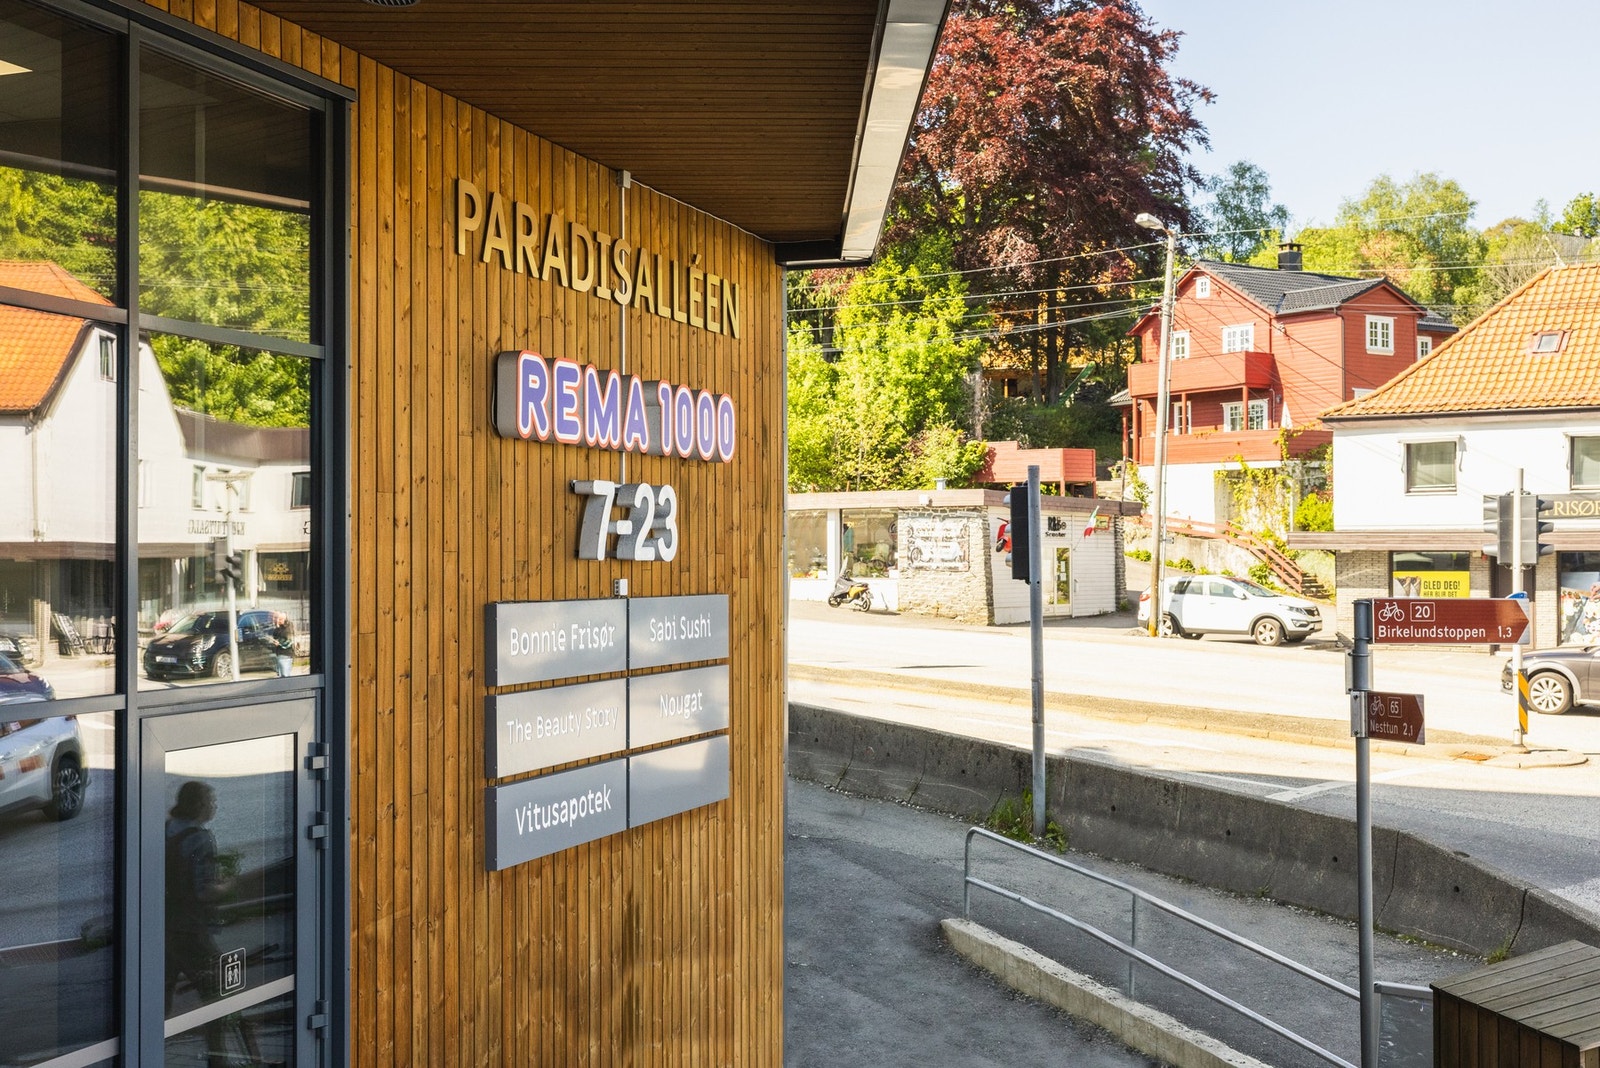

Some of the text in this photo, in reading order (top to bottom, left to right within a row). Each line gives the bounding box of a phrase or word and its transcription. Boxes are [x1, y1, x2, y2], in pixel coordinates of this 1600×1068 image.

[457, 178, 740, 339] PARADISALLÉEN
[517, 350, 736, 464] REMA 1000
[591, 479, 678, 563] 7-23
[1423, 581, 1460, 590] GLED DEG!
[649, 613, 712, 642] Sabi Sushi
[1415, 606, 1430, 618] 20
[510, 620, 616, 656] Bonnie Frisør
[1378, 625, 1512, 640] Birkelundstoppen 1,3
[659, 688, 703, 722] Nougat
[1390, 701, 1399, 714] 65
[506, 706, 619, 744] The Beauty Story
[1370, 719, 1414, 737] Nesttun 2,1
[515, 784, 612, 836] Vitusapotek
